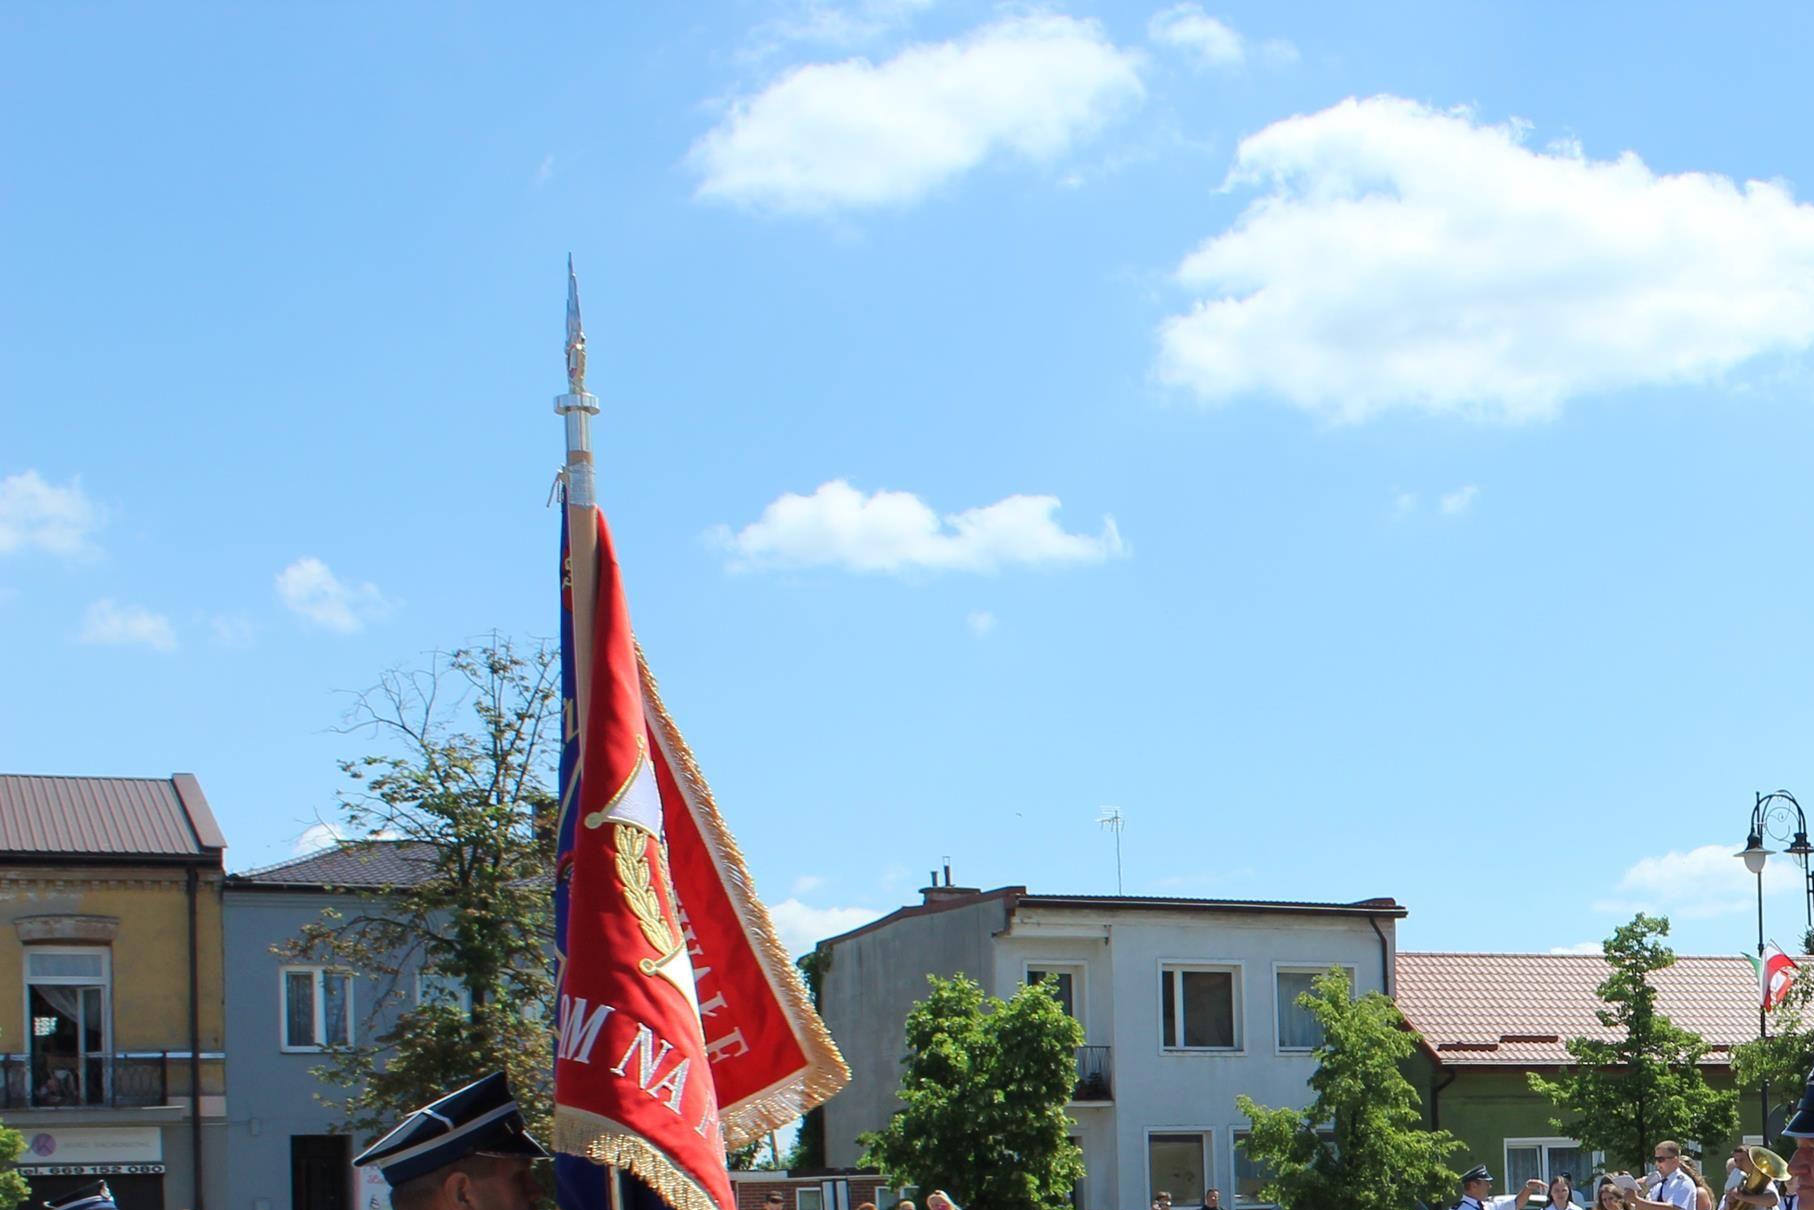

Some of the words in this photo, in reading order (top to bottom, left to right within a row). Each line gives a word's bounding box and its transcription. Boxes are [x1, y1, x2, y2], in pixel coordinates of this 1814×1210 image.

[609, 1022, 692, 1115] NA
[89, 1166, 122, 1174] 152
[128, 1165, 162, 1173] 080
